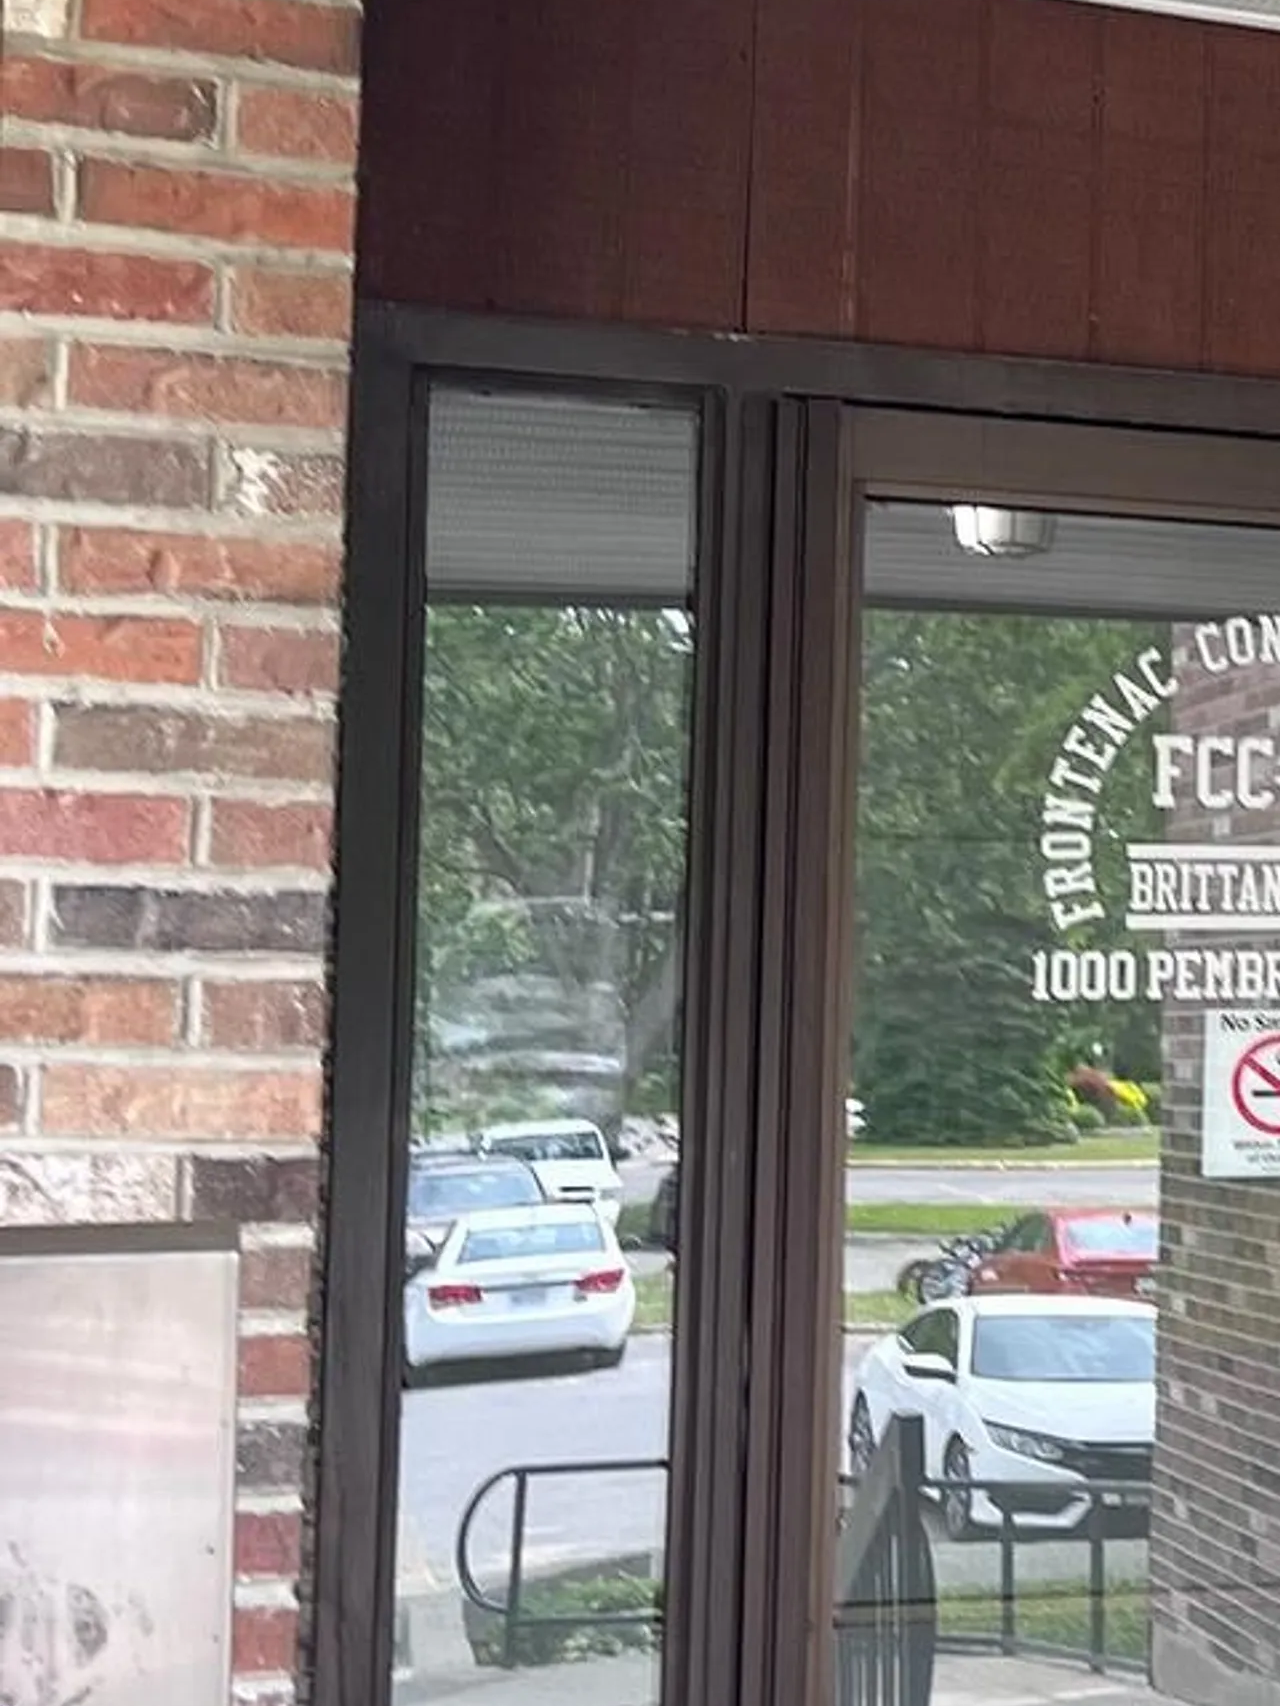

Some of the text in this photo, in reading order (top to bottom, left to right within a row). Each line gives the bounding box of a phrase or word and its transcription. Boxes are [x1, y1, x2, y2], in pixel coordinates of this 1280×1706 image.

[1040, 646, 1179, 931] FRONTENAC
[1032, 949, 1136, 1001] 1000
[1219, 1012, 1250, 1031] No
